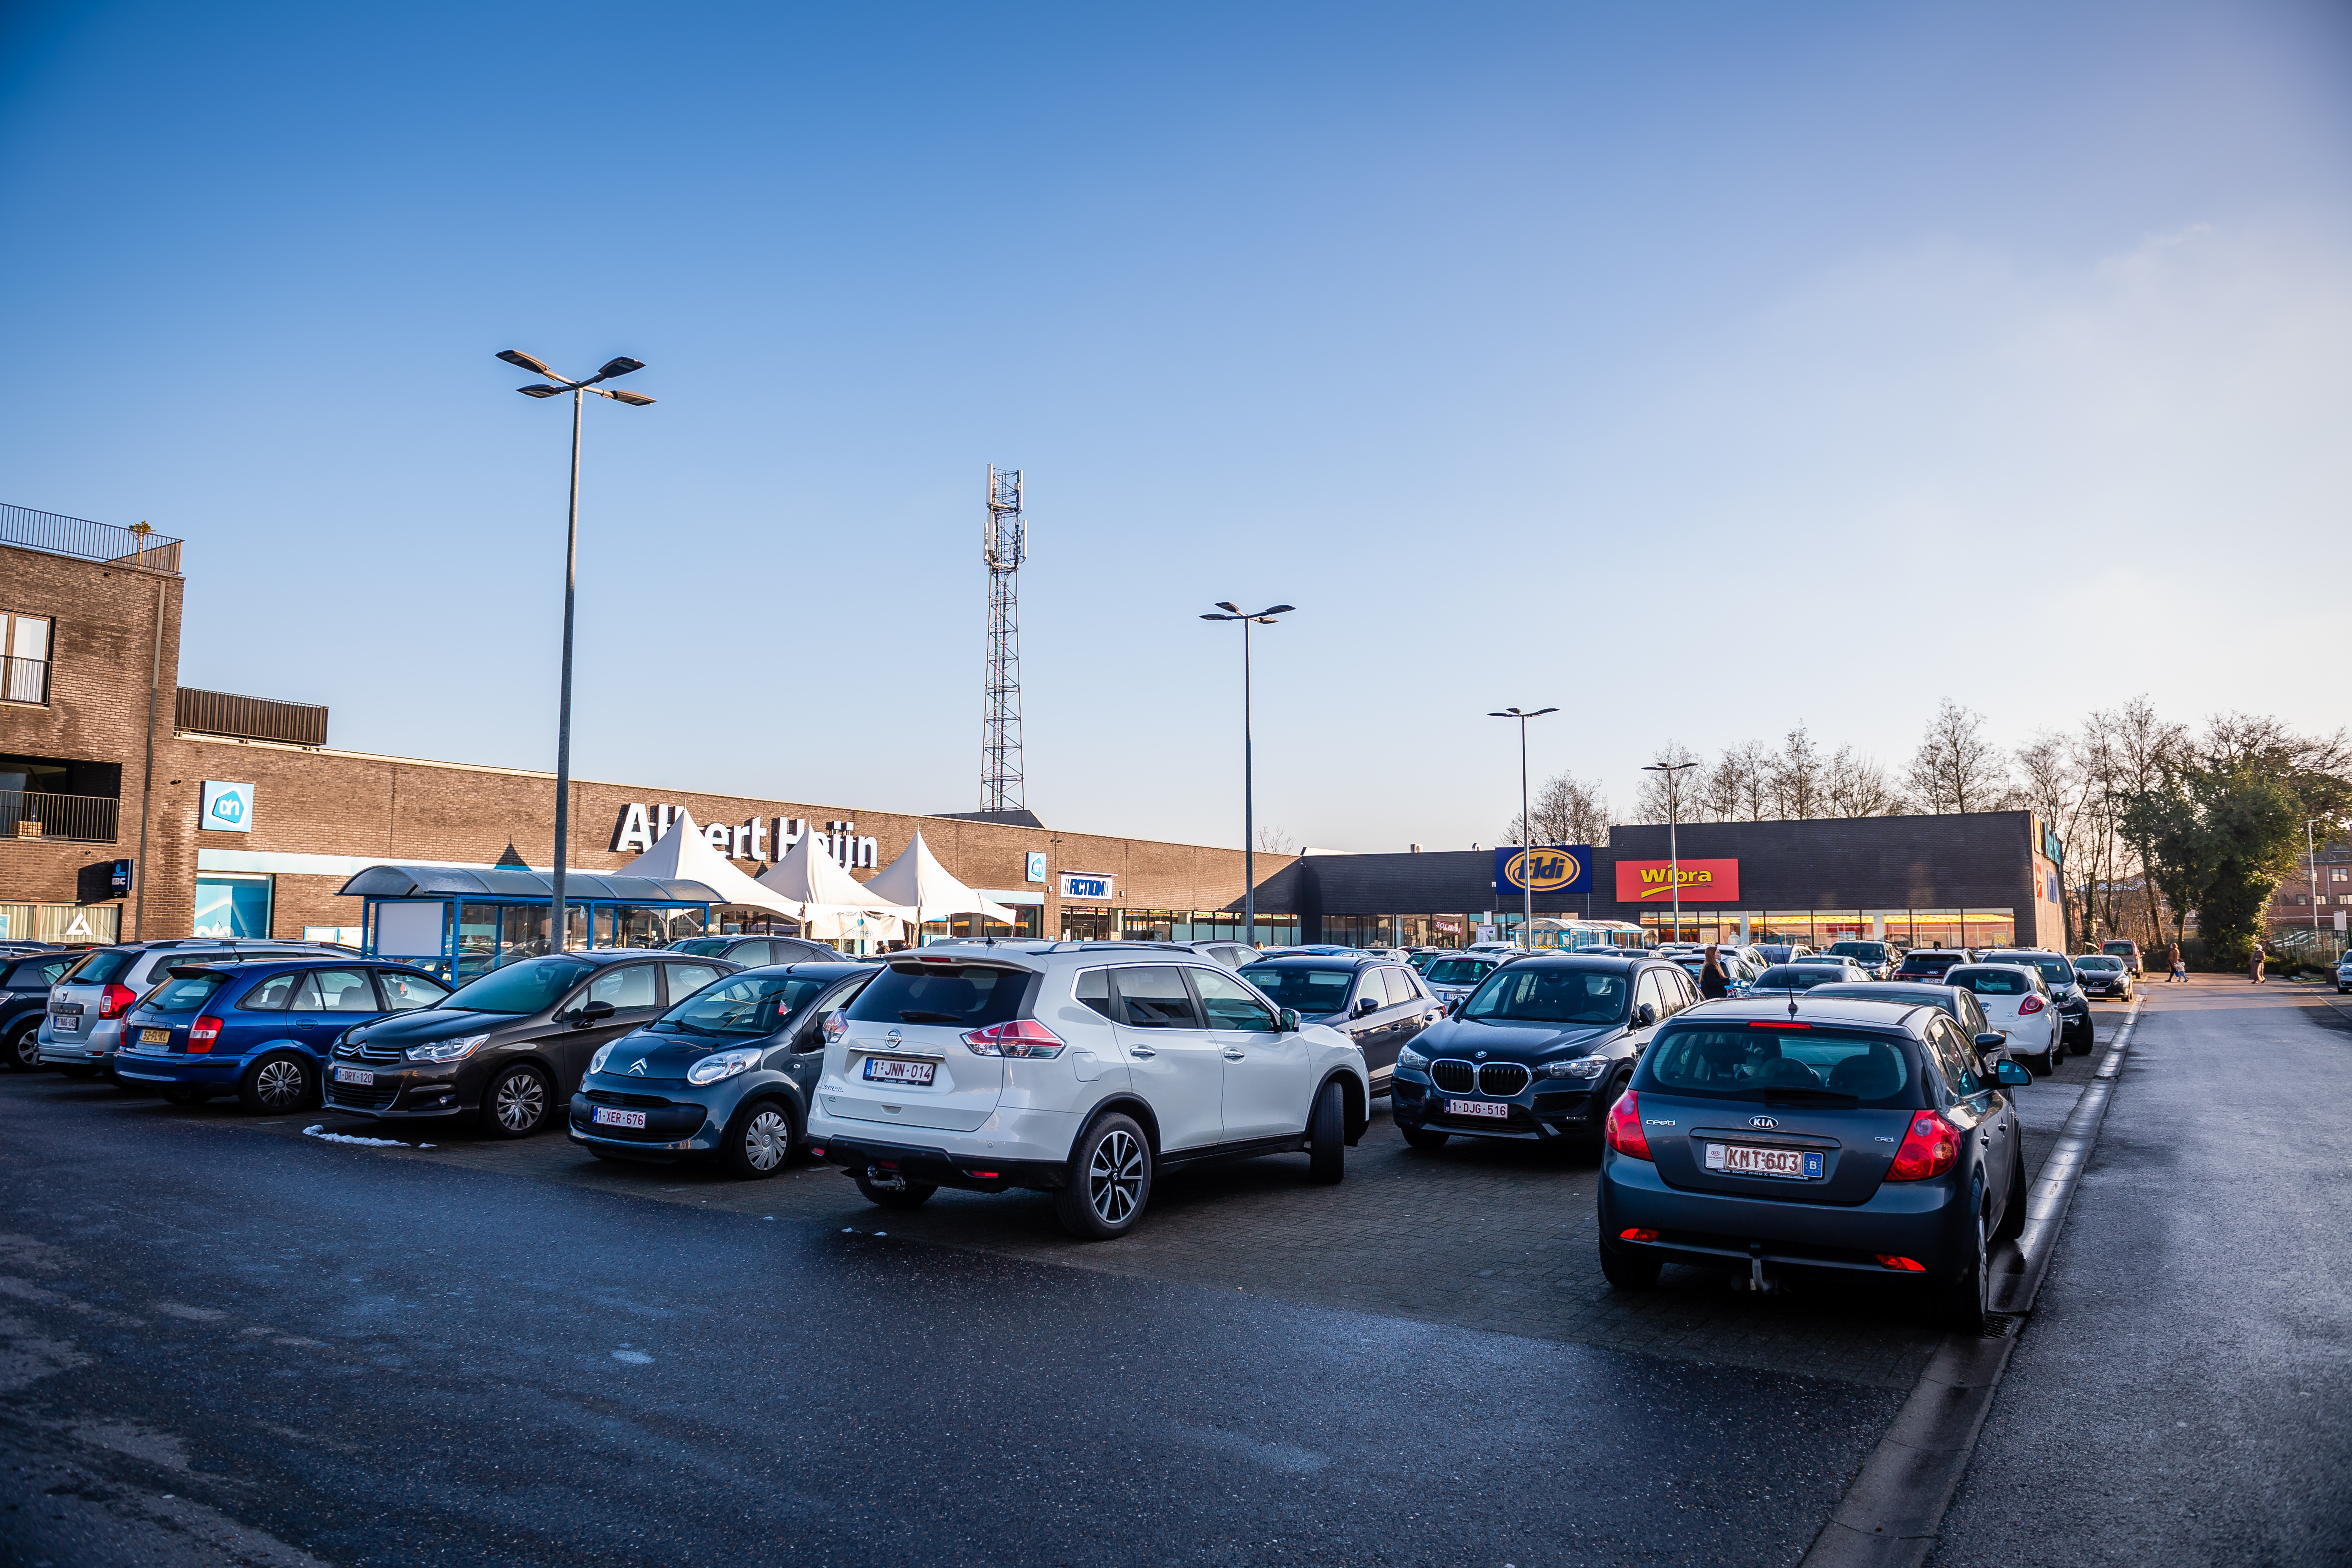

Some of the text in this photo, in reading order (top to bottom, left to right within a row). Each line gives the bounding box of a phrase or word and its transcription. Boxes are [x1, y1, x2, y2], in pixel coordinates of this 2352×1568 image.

[219, 799, 240, 816] ah
[615, 803, 767, 861] Alert
[1034, 863, 1042, 873] ah
[1517, 856, 1565, 879] Eldi
[1640, 864, 1712, 882] Wibra
[1070, 879, 1105, 896] ACTION
[1436, 921, 1462, 934] SOLDEN
[143, 1030, 166, 1042] 52-FL-KL
[339, 1070, 372, 1083] 1-DRY-120
[874, 1061, 932, 1079] 1-JNN-014
[1452, 1102, 1506, 1116] 1-DJG-516
[598, 1110, 644, 1126] 1-XER-676
[1753, 1118, 1774, 1127] KIA
[1729, 1149, 1817, 1171] KMT-603 B
